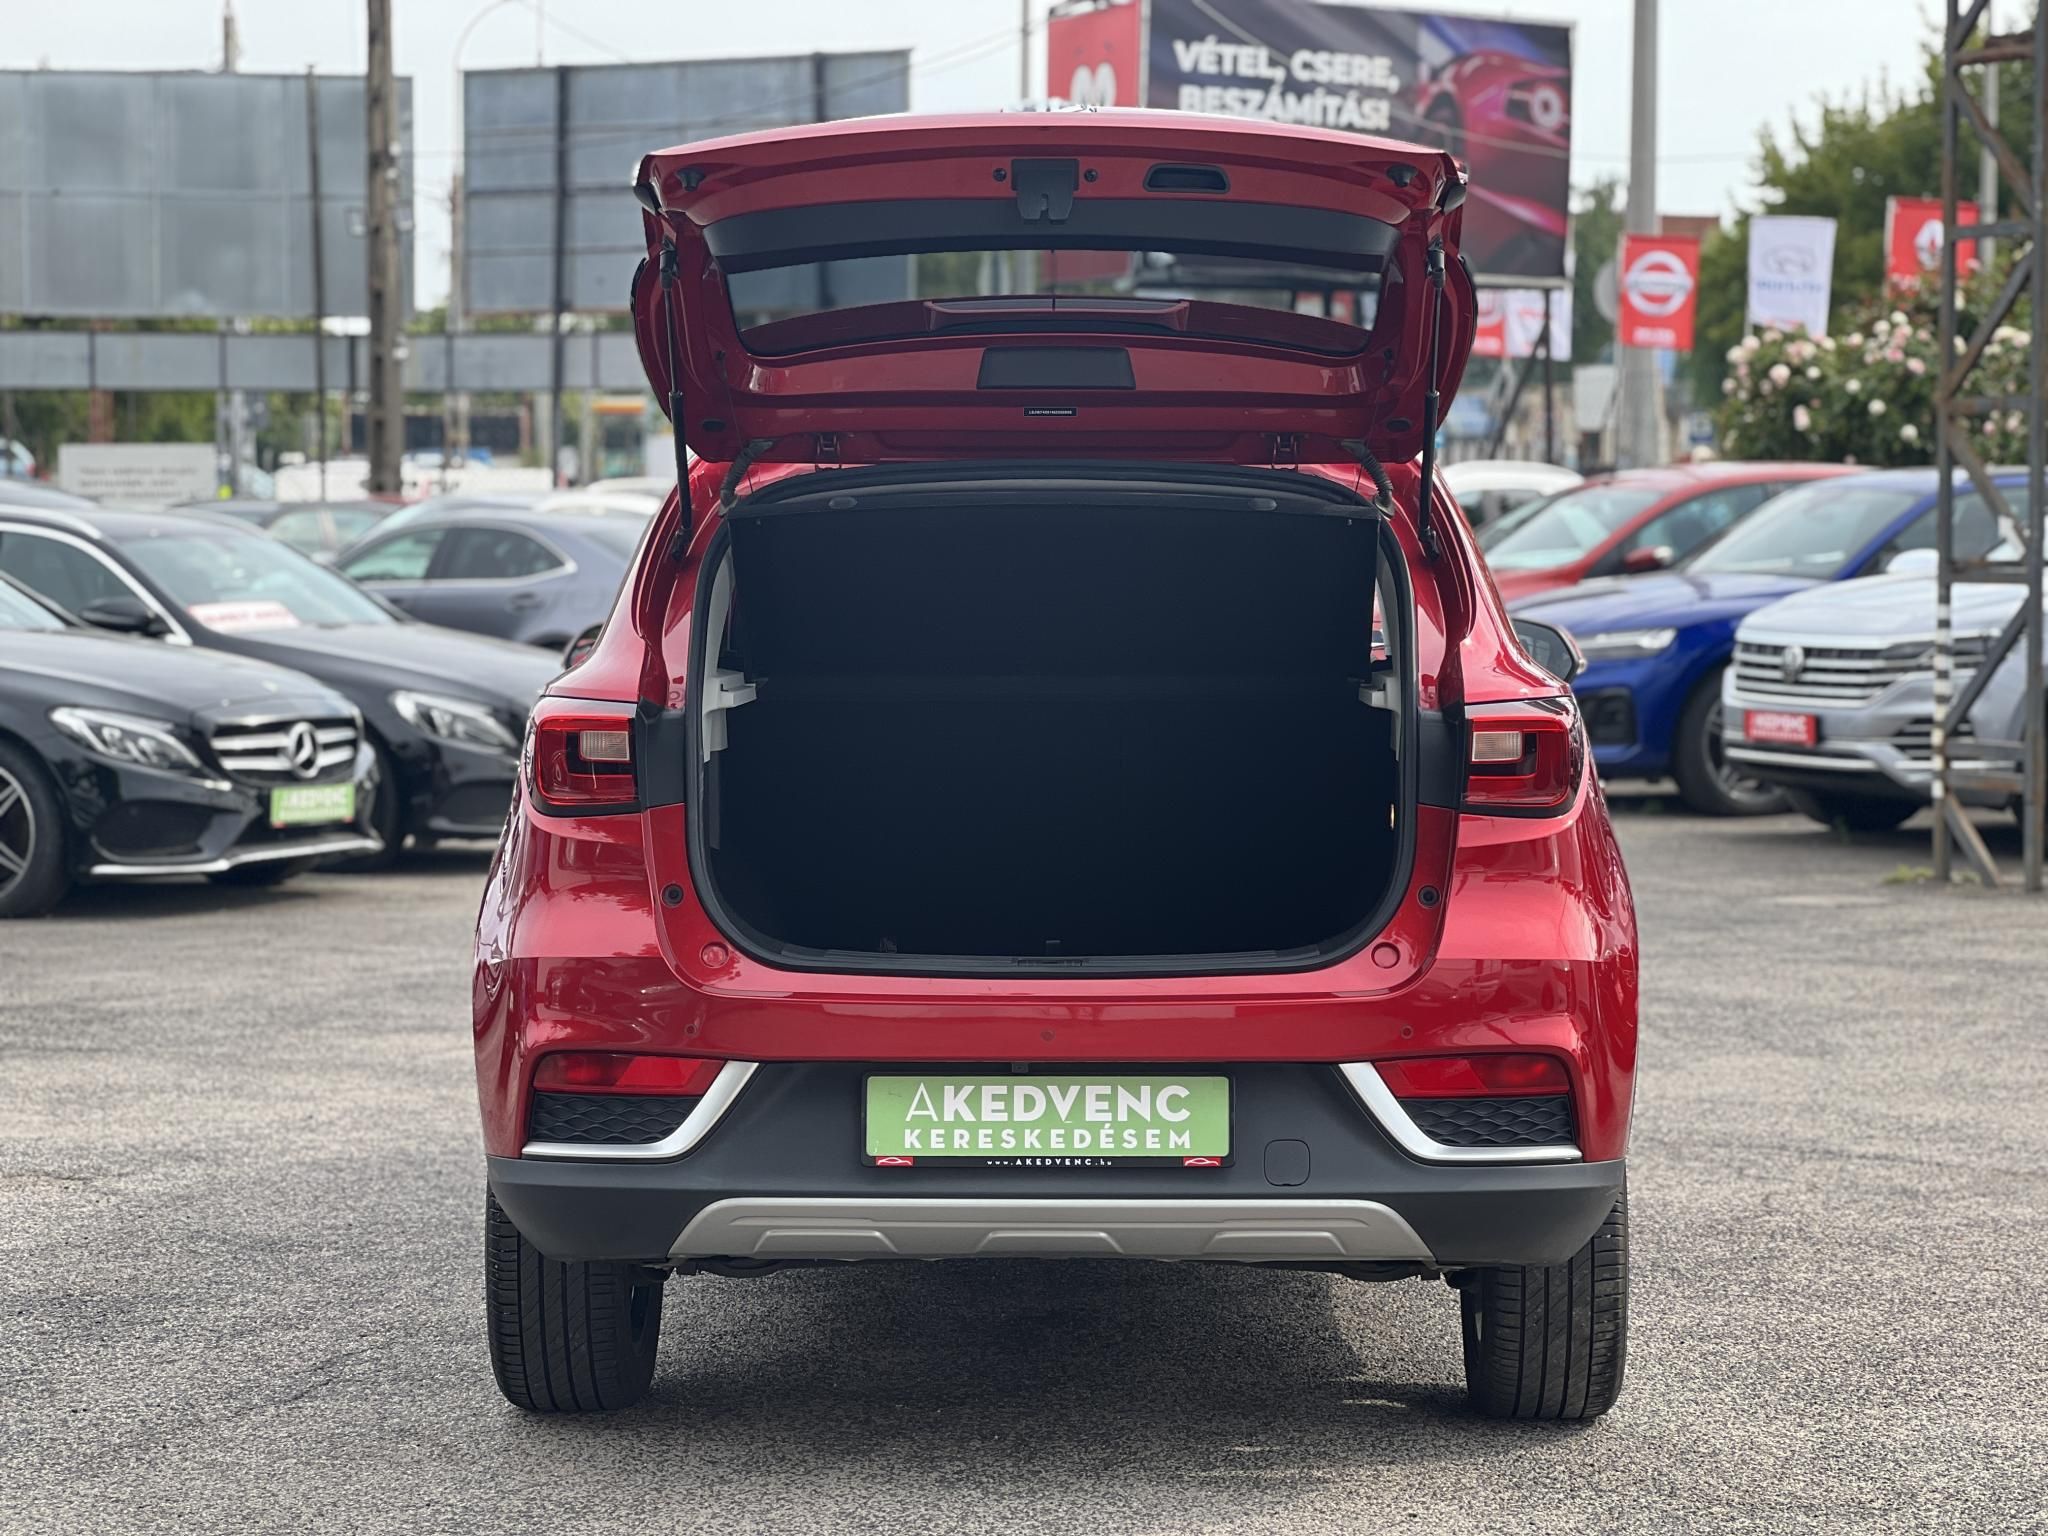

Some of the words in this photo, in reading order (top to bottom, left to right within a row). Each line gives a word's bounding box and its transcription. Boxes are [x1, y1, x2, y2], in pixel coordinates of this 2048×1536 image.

[1173, 35, 1286, 83] VÉTEL,
[1290, 50, 1400, 93] CSERE,
[905, 1082, 1191, 1122] AKEDVENC
[904, 1124, 1191, 1148] KERESKEDÉSEM
[986, 1158, 1112, 1167] www.AKEDVENC.hu
